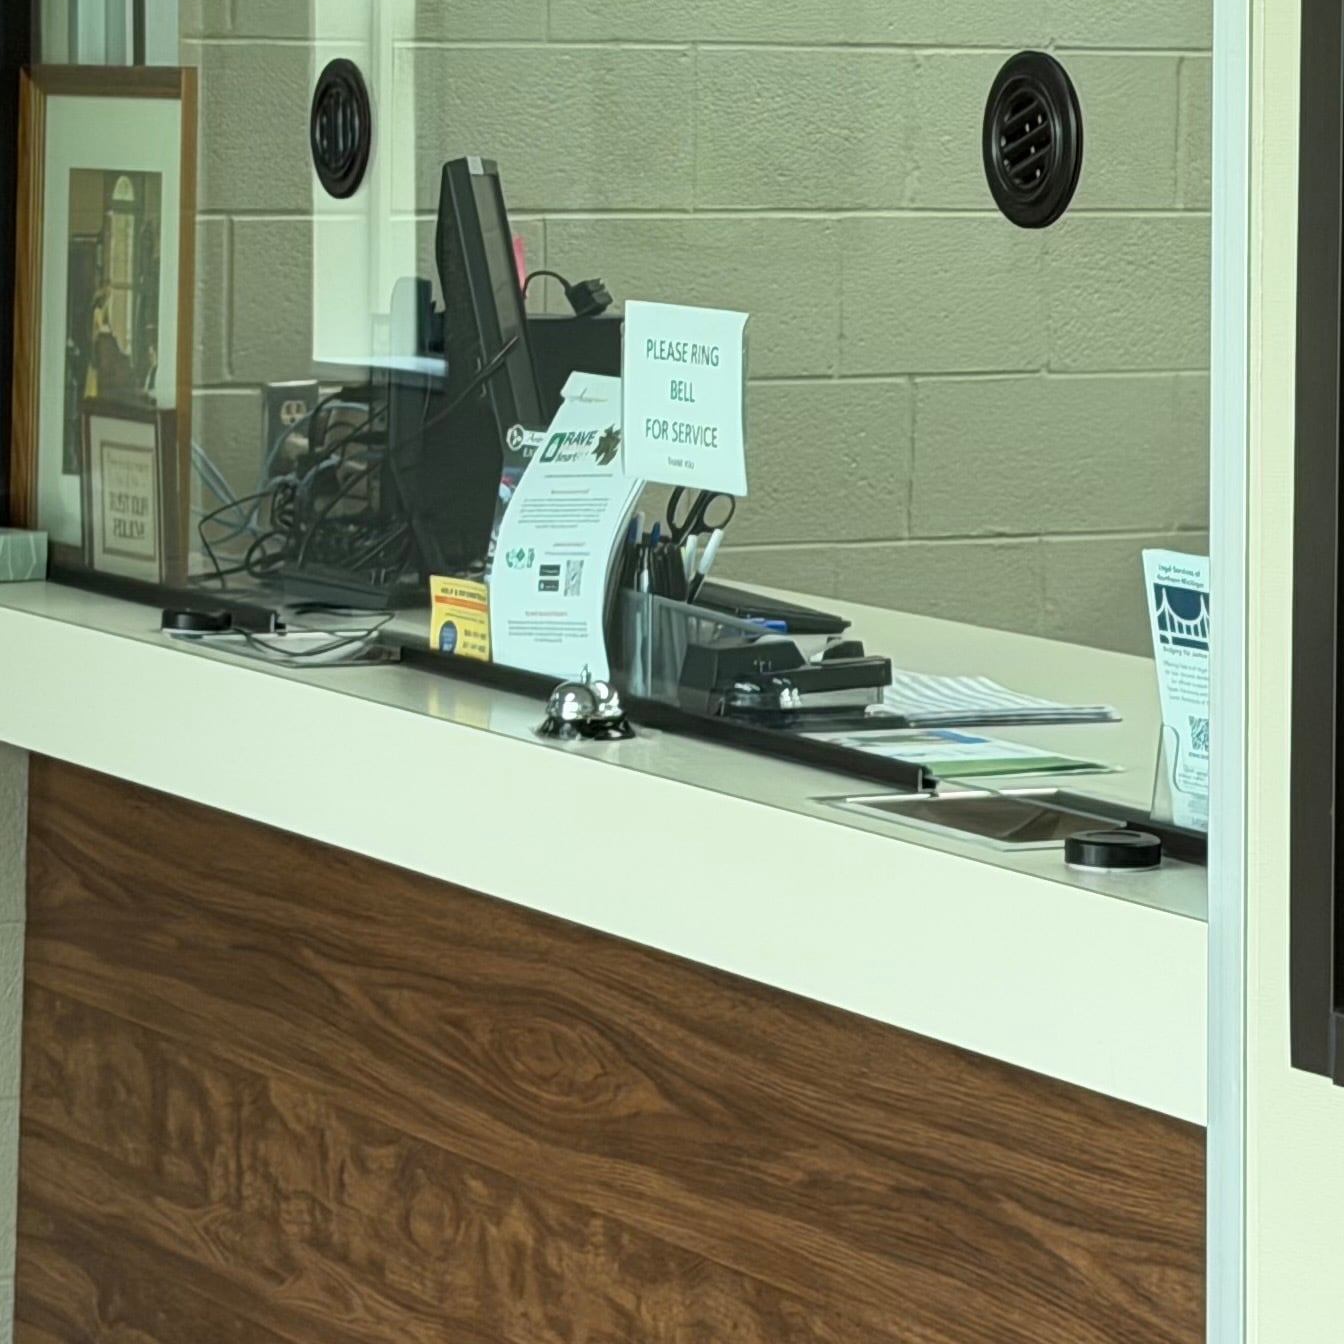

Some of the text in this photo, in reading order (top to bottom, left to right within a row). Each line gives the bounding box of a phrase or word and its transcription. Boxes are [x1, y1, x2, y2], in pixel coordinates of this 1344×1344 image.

[646, 339, 719, 367] PLEASE RING
[670, 379, 696, 403] BELL
[564, 430, 598, 446] RAVE
[645, 418, 718, 449] FOR SERVICE
